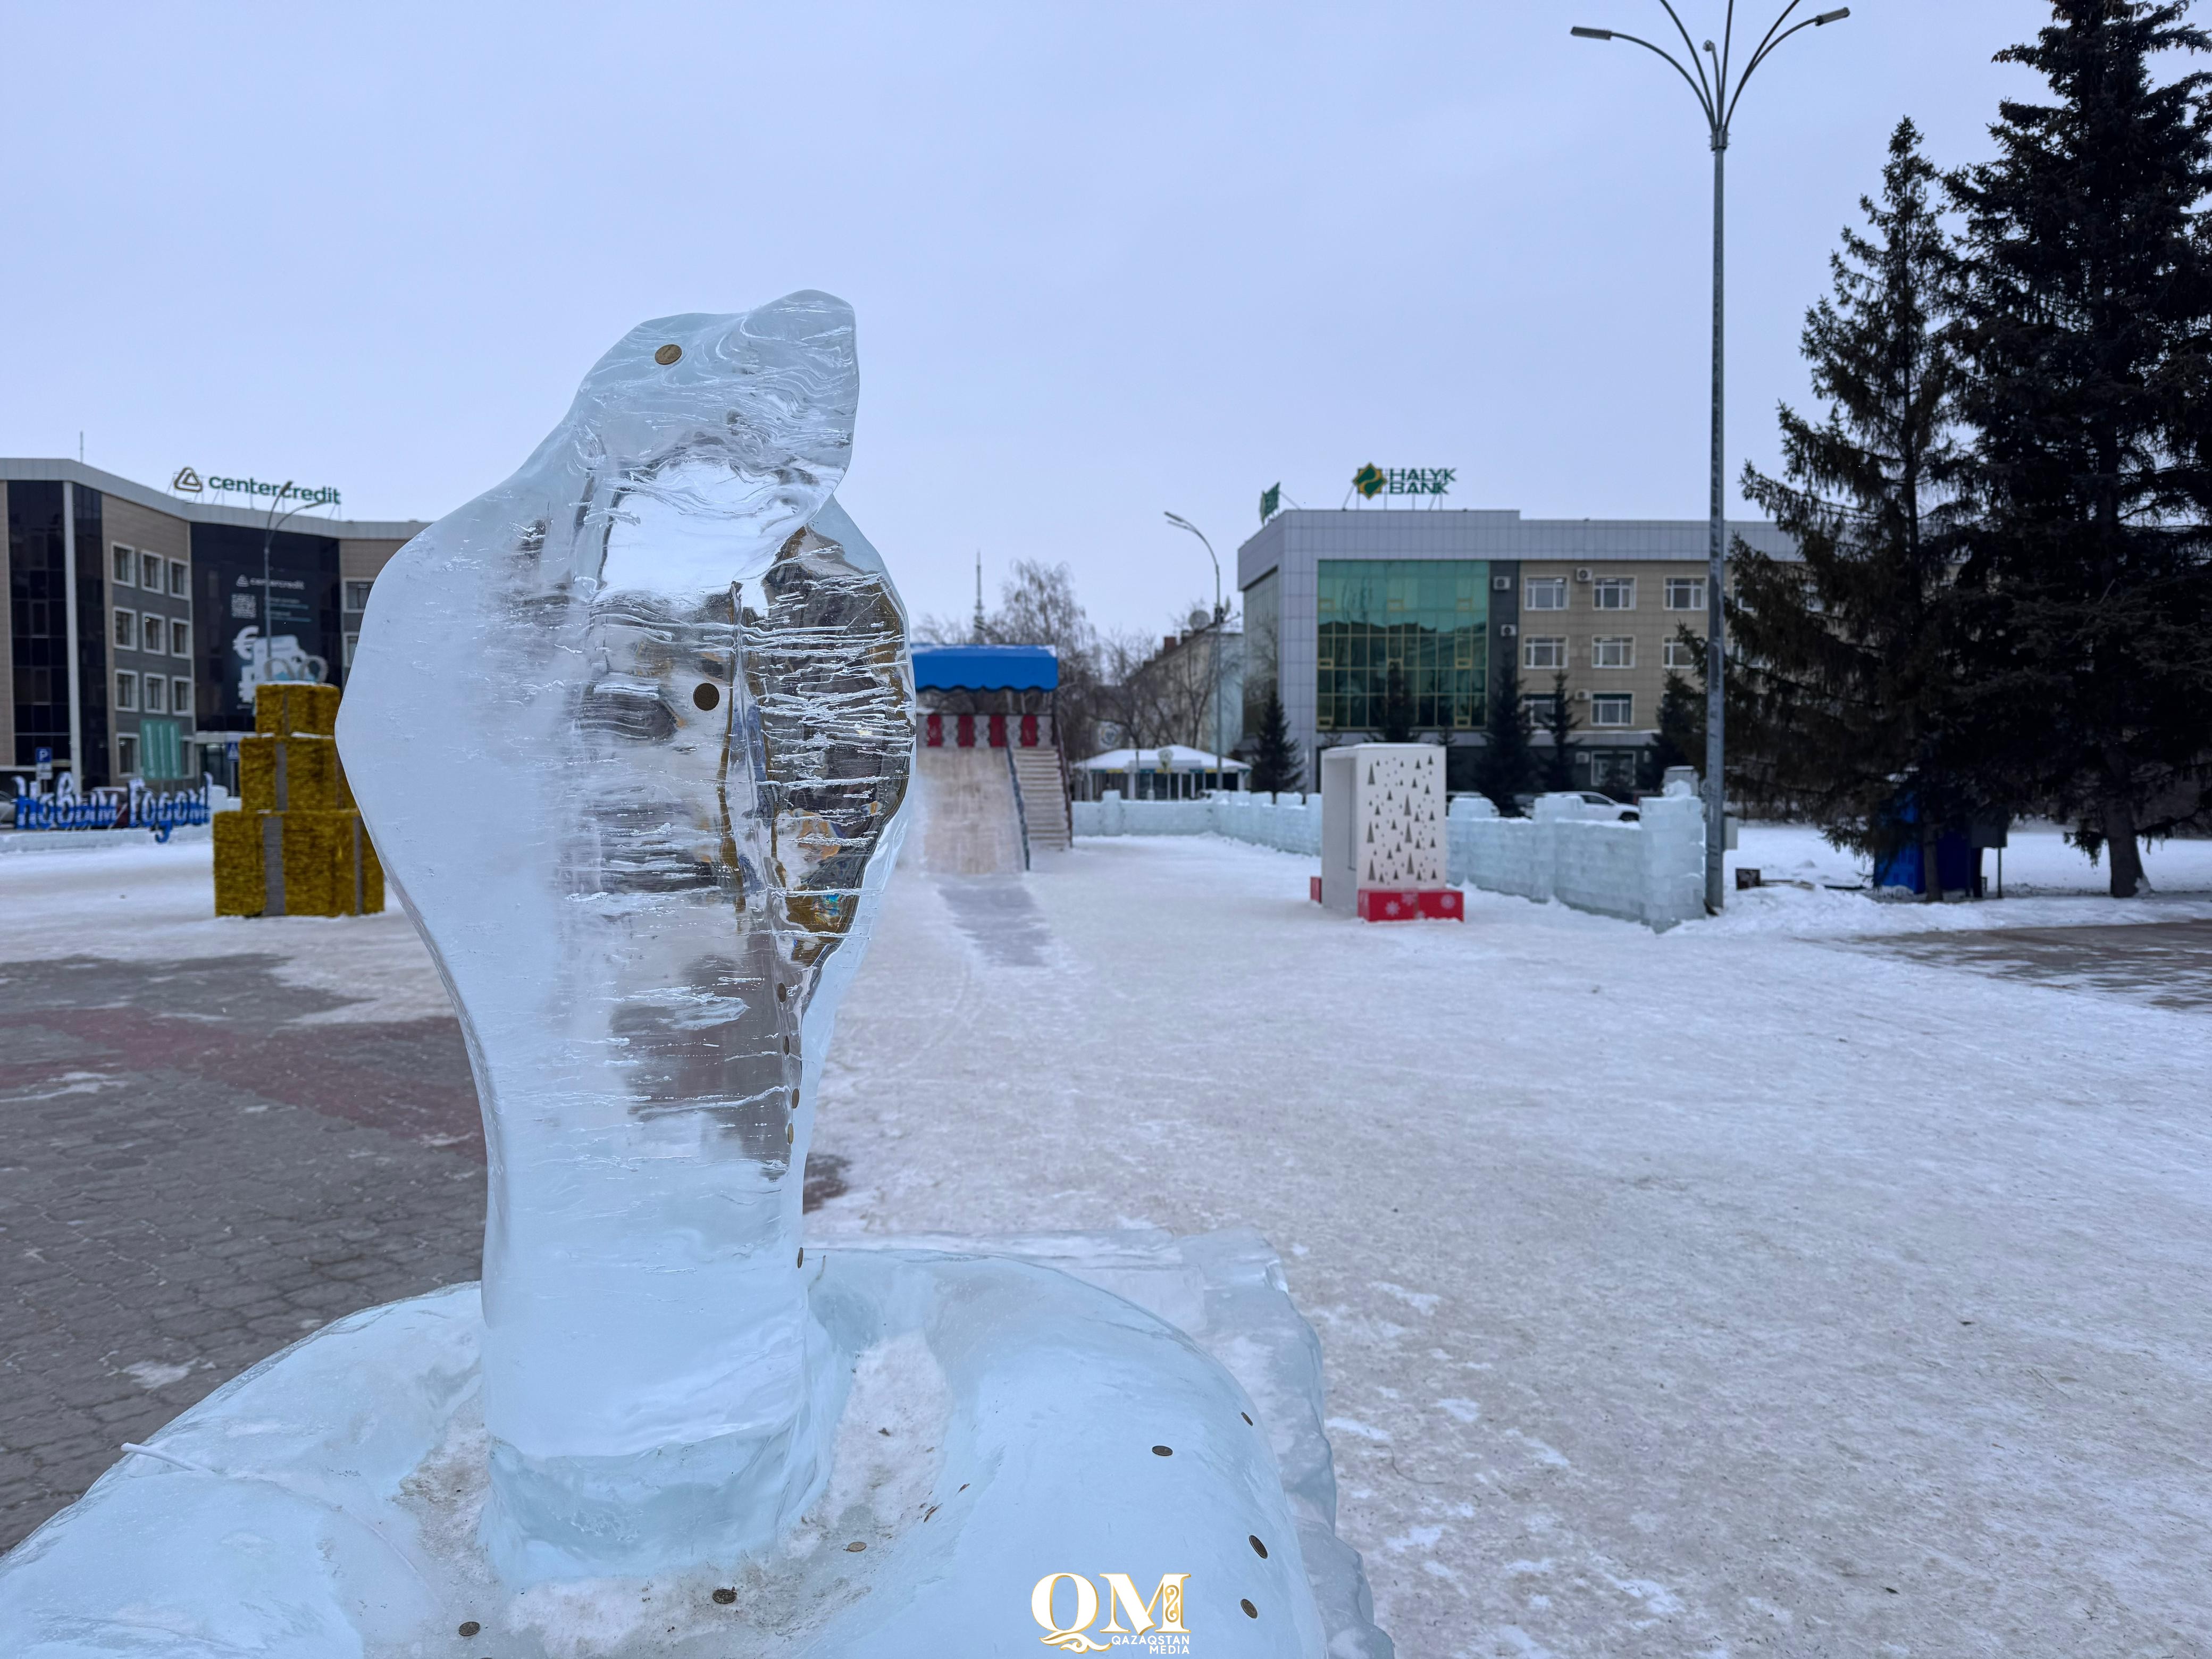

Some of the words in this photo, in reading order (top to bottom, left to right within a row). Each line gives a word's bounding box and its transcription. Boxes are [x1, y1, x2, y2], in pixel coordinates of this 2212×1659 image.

[1390, 468, 1456, 482] HALYK
[209, 476, 340, 504] centercredit
[1390, 482, 1449, 494] BANK
[40, 749, 48, 761] P
